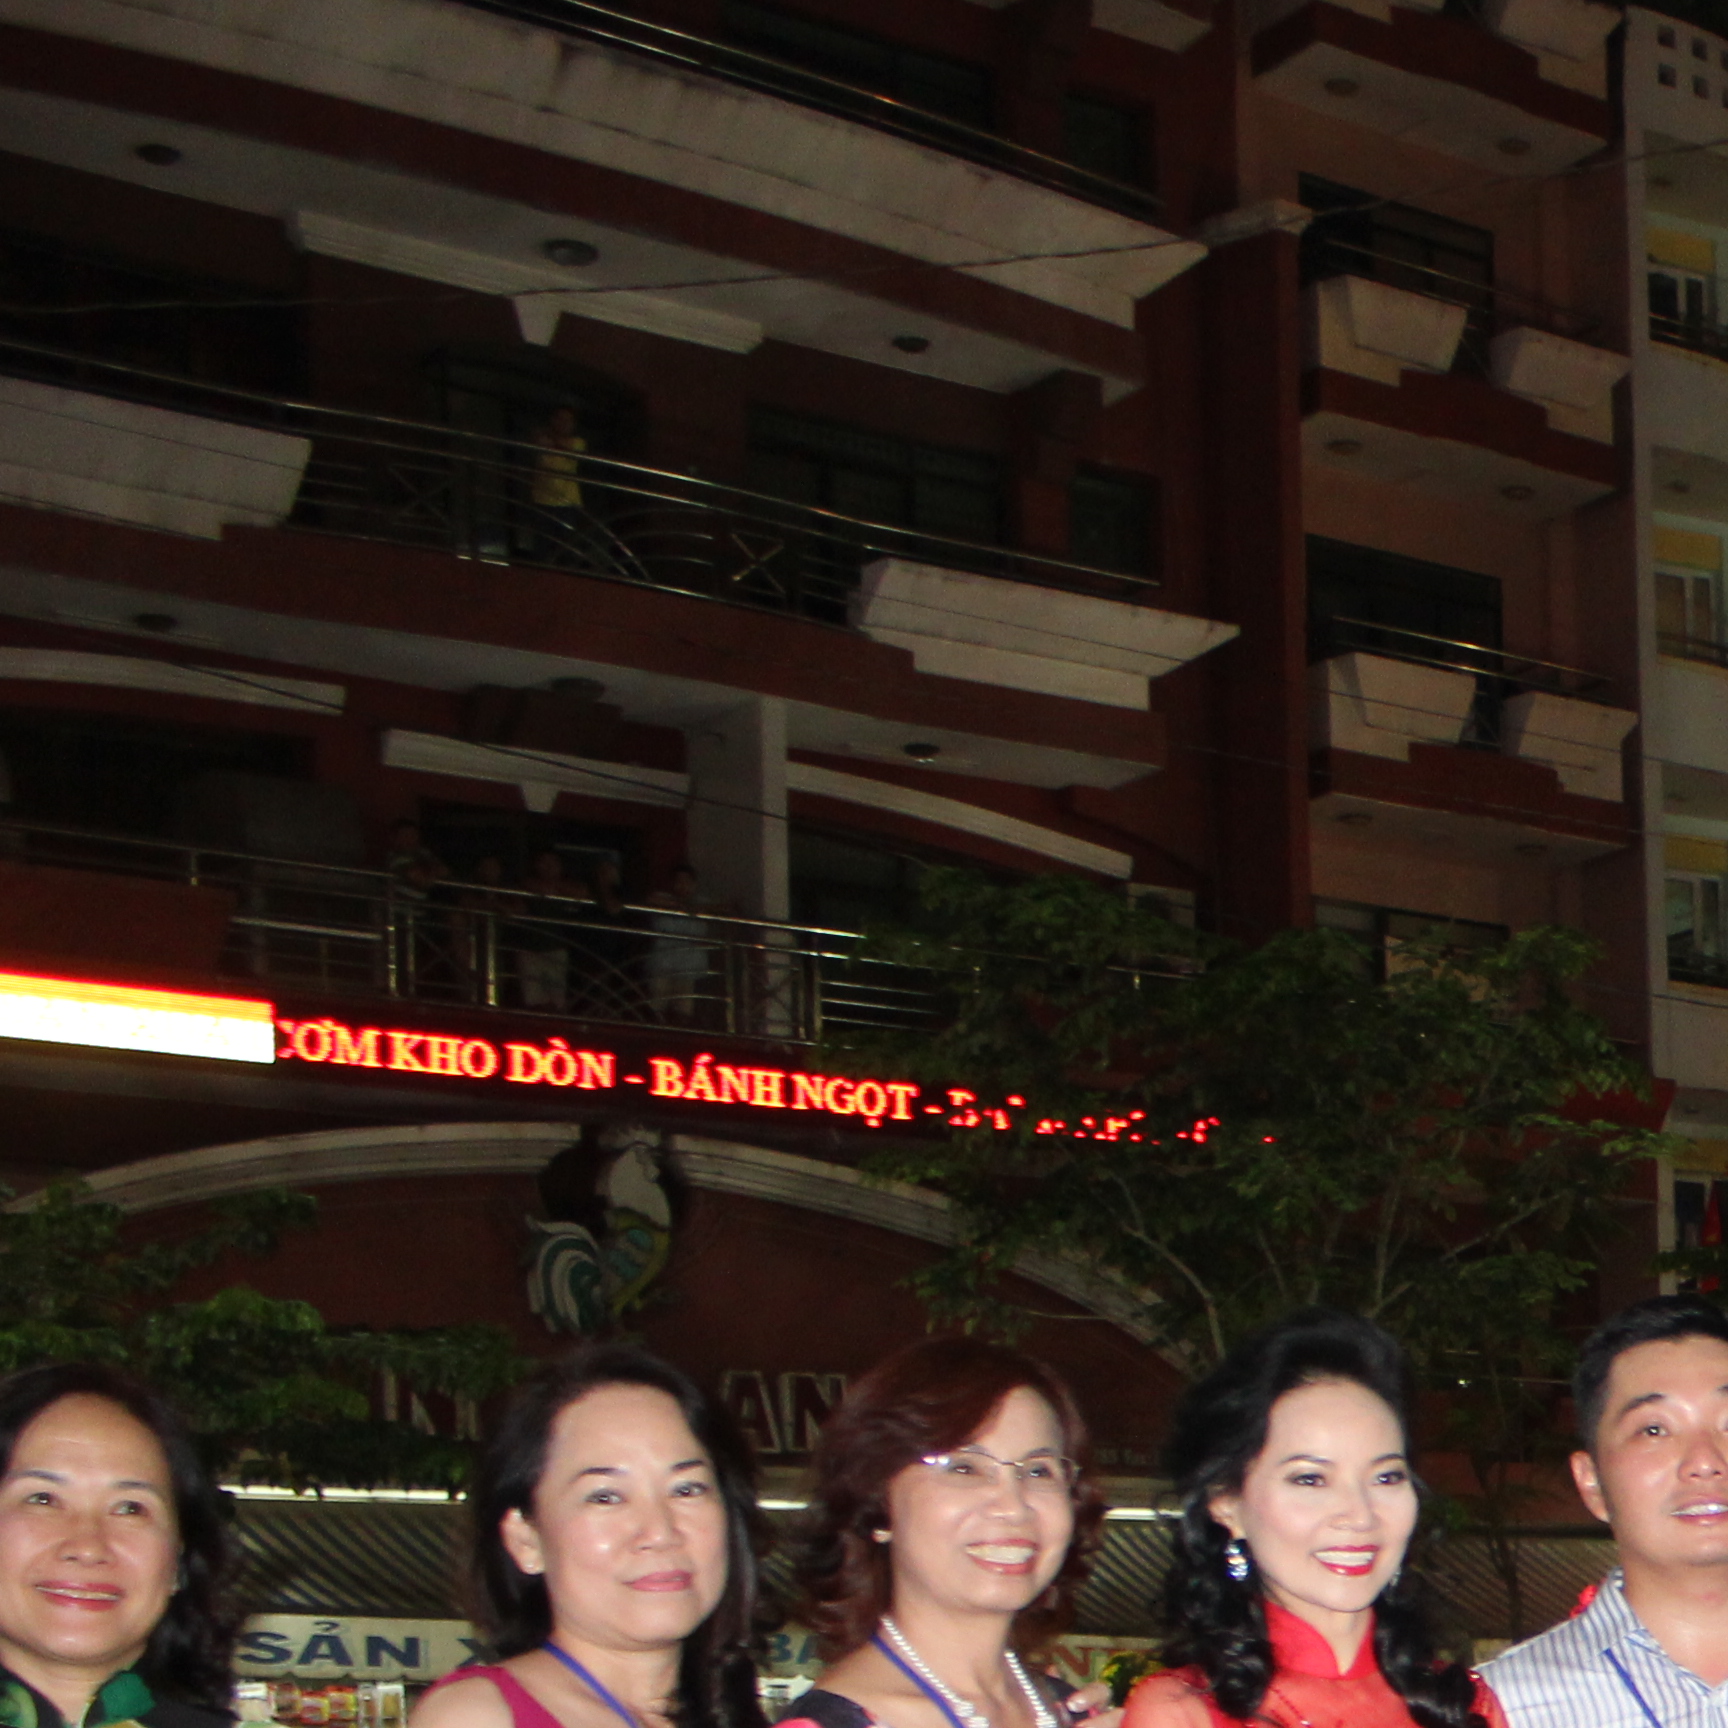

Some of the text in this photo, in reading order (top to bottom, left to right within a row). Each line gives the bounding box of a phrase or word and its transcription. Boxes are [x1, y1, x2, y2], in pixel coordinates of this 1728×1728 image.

[384, 1030, 499, 1079] KHO
[504, 1037, 617, 1090] DÒN
[649, 1053, 787, 1109] BÁNH
[791, 1071, 920, 1129] NGỌT
[238, 1620, 422, 1669] SẢN
